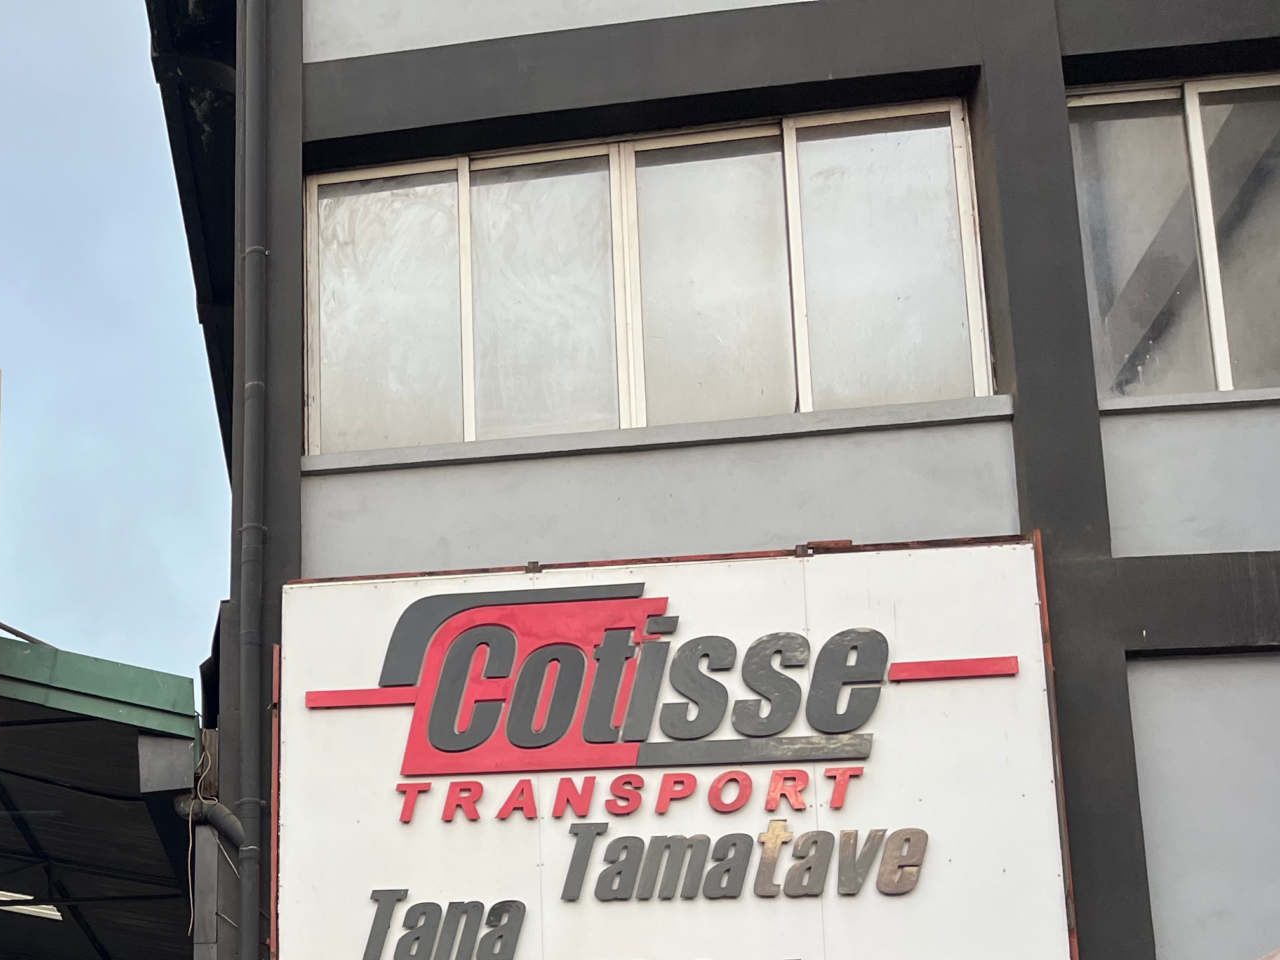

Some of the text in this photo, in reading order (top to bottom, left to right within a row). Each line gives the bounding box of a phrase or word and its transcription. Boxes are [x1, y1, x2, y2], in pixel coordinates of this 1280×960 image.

[427, 615, 889, 753] Cotisse
[395, 766, 864, 823] TRANSPORT
[561, 819, 929, 902] Tamatave
